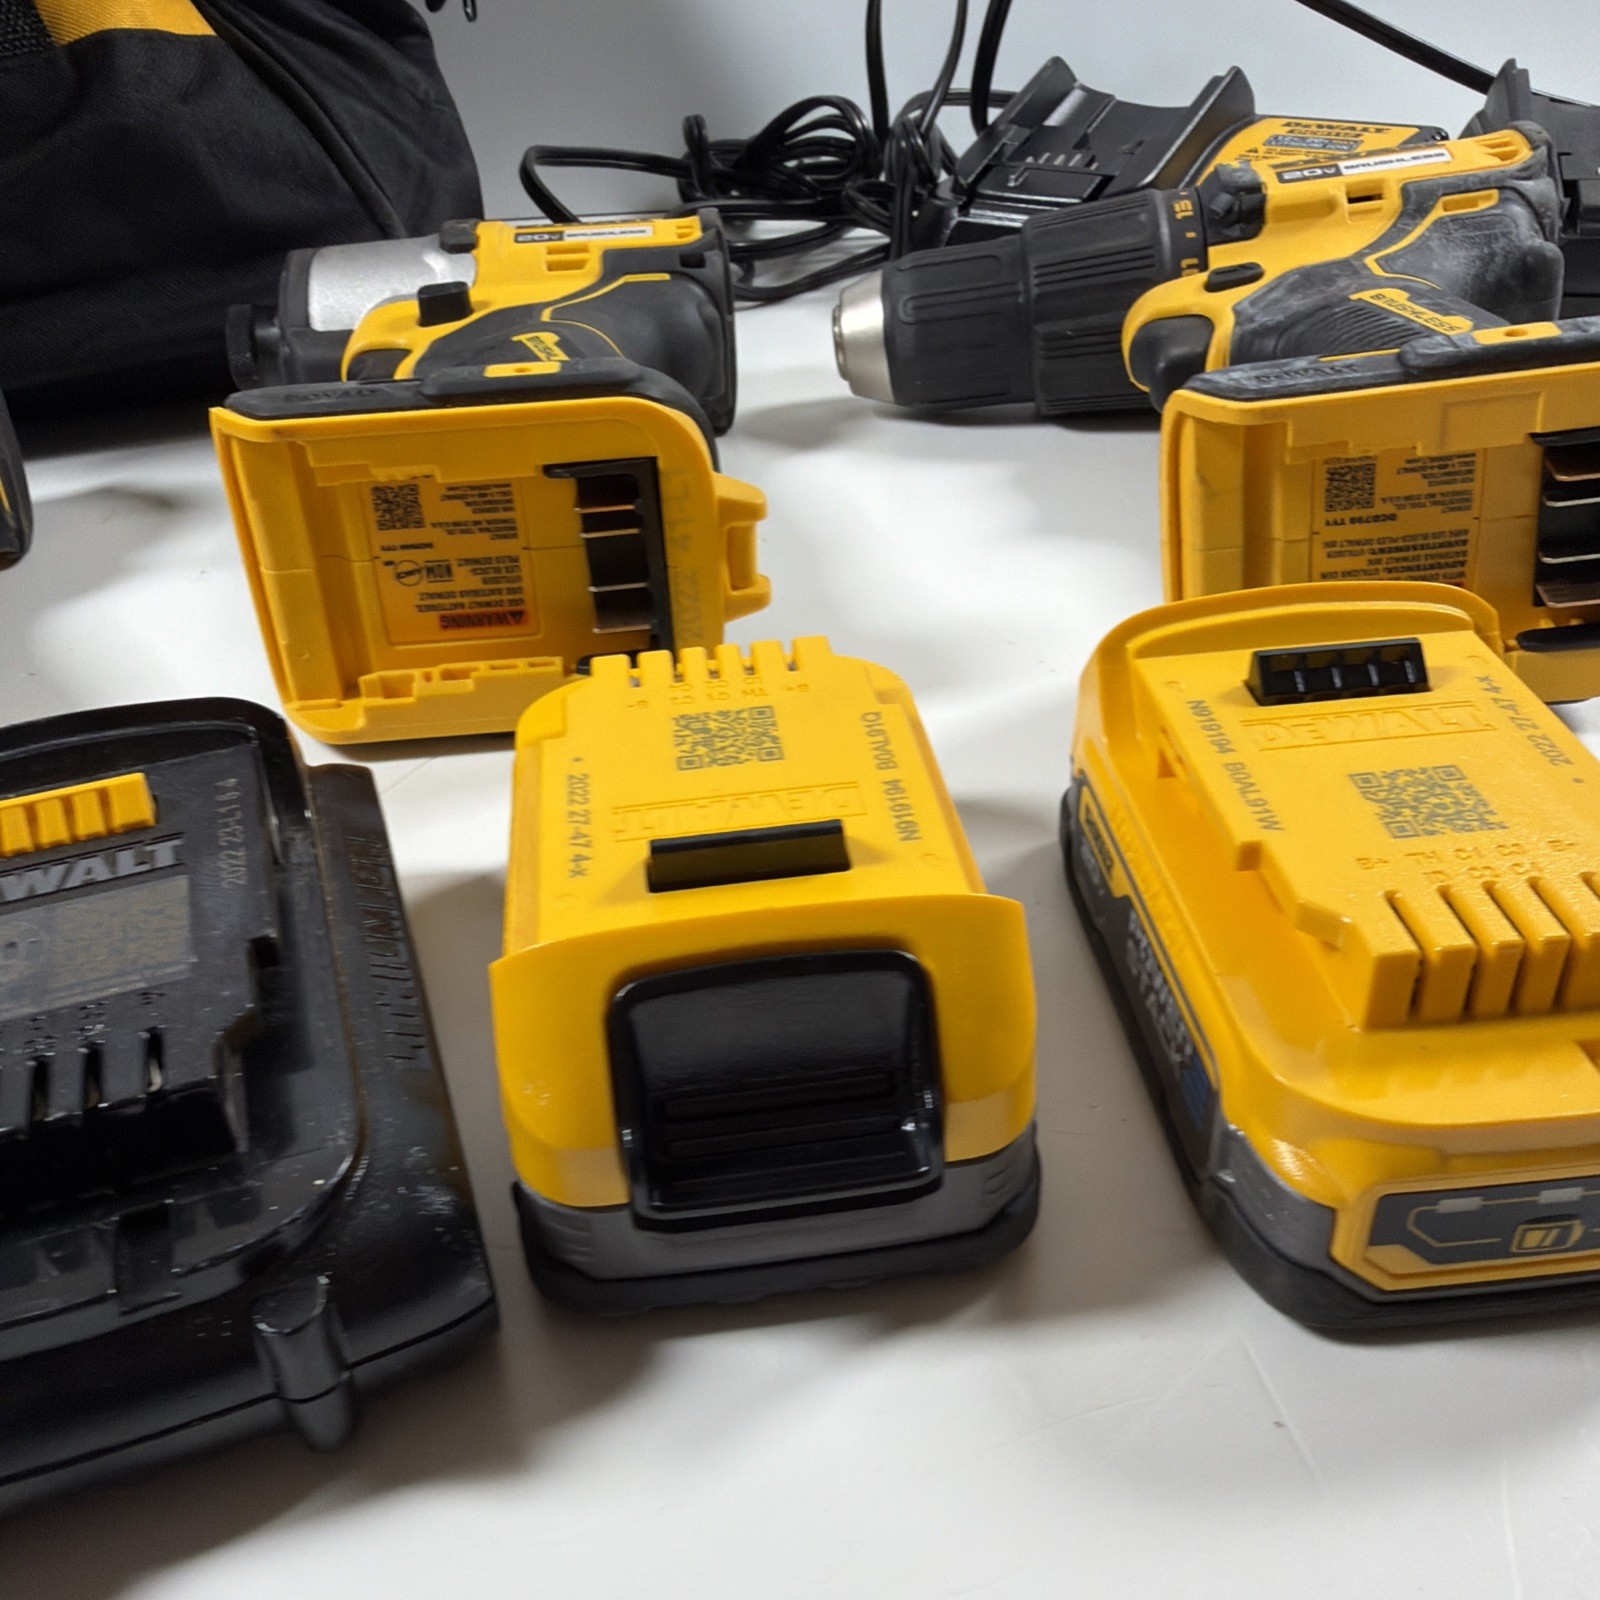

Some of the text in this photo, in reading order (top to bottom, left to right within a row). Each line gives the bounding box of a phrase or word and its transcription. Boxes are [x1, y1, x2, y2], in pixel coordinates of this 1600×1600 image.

[1343, 152, 1447, 171] BRUSHLESS
[1171, 199, 1194, 221] 15
[1370, 293, 1462, 332] BRUSHLESS
[1493, 696, 1541, 732] 27-47
[1527, 731, 1574, 767] 2022
[567, 772, 589, 805] 2022
[567, 811, 592, 849] 27-47
[218, 847, 248, 889] 2022
